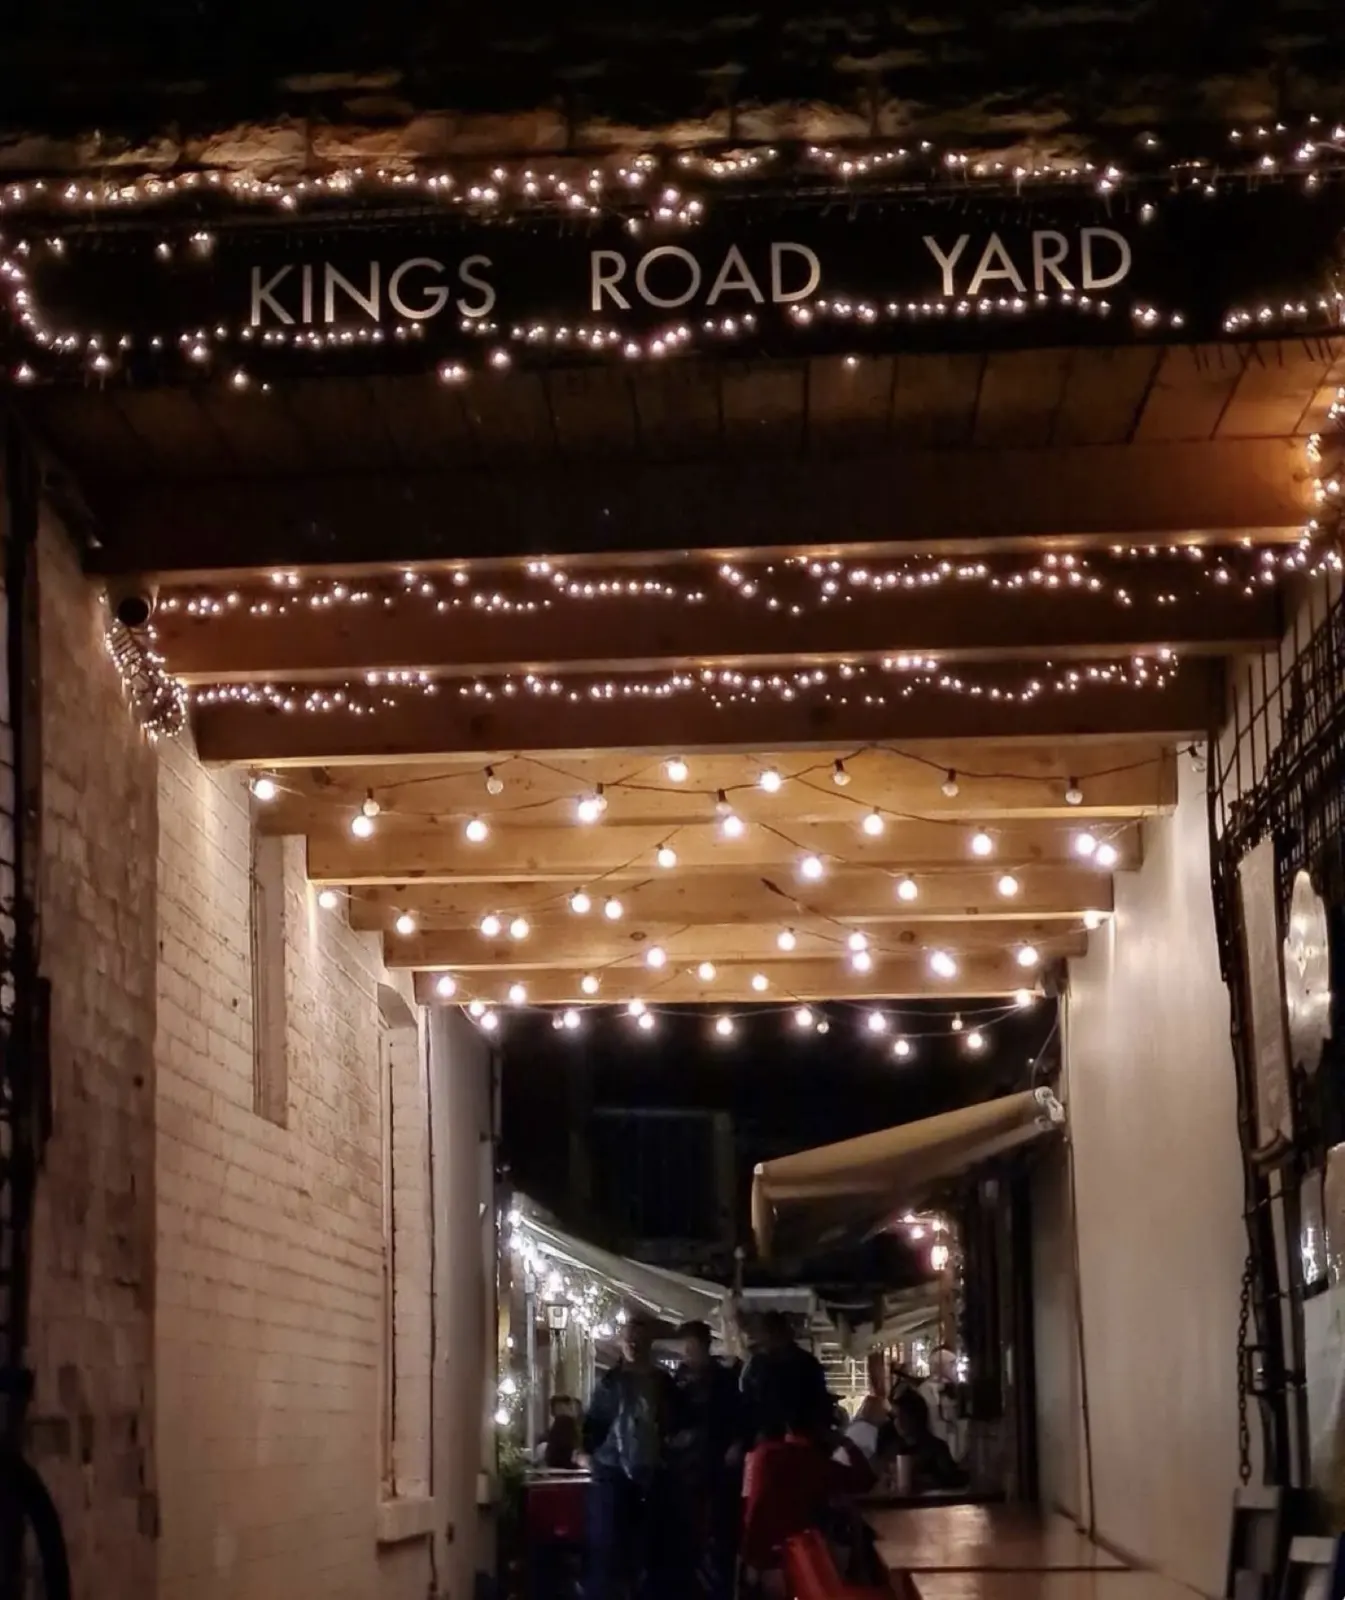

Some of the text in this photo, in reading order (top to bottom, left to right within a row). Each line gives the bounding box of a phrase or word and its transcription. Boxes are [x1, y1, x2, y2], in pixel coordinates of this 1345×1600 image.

[250, 227, 1132, 327] KINGS ROAD YARD
